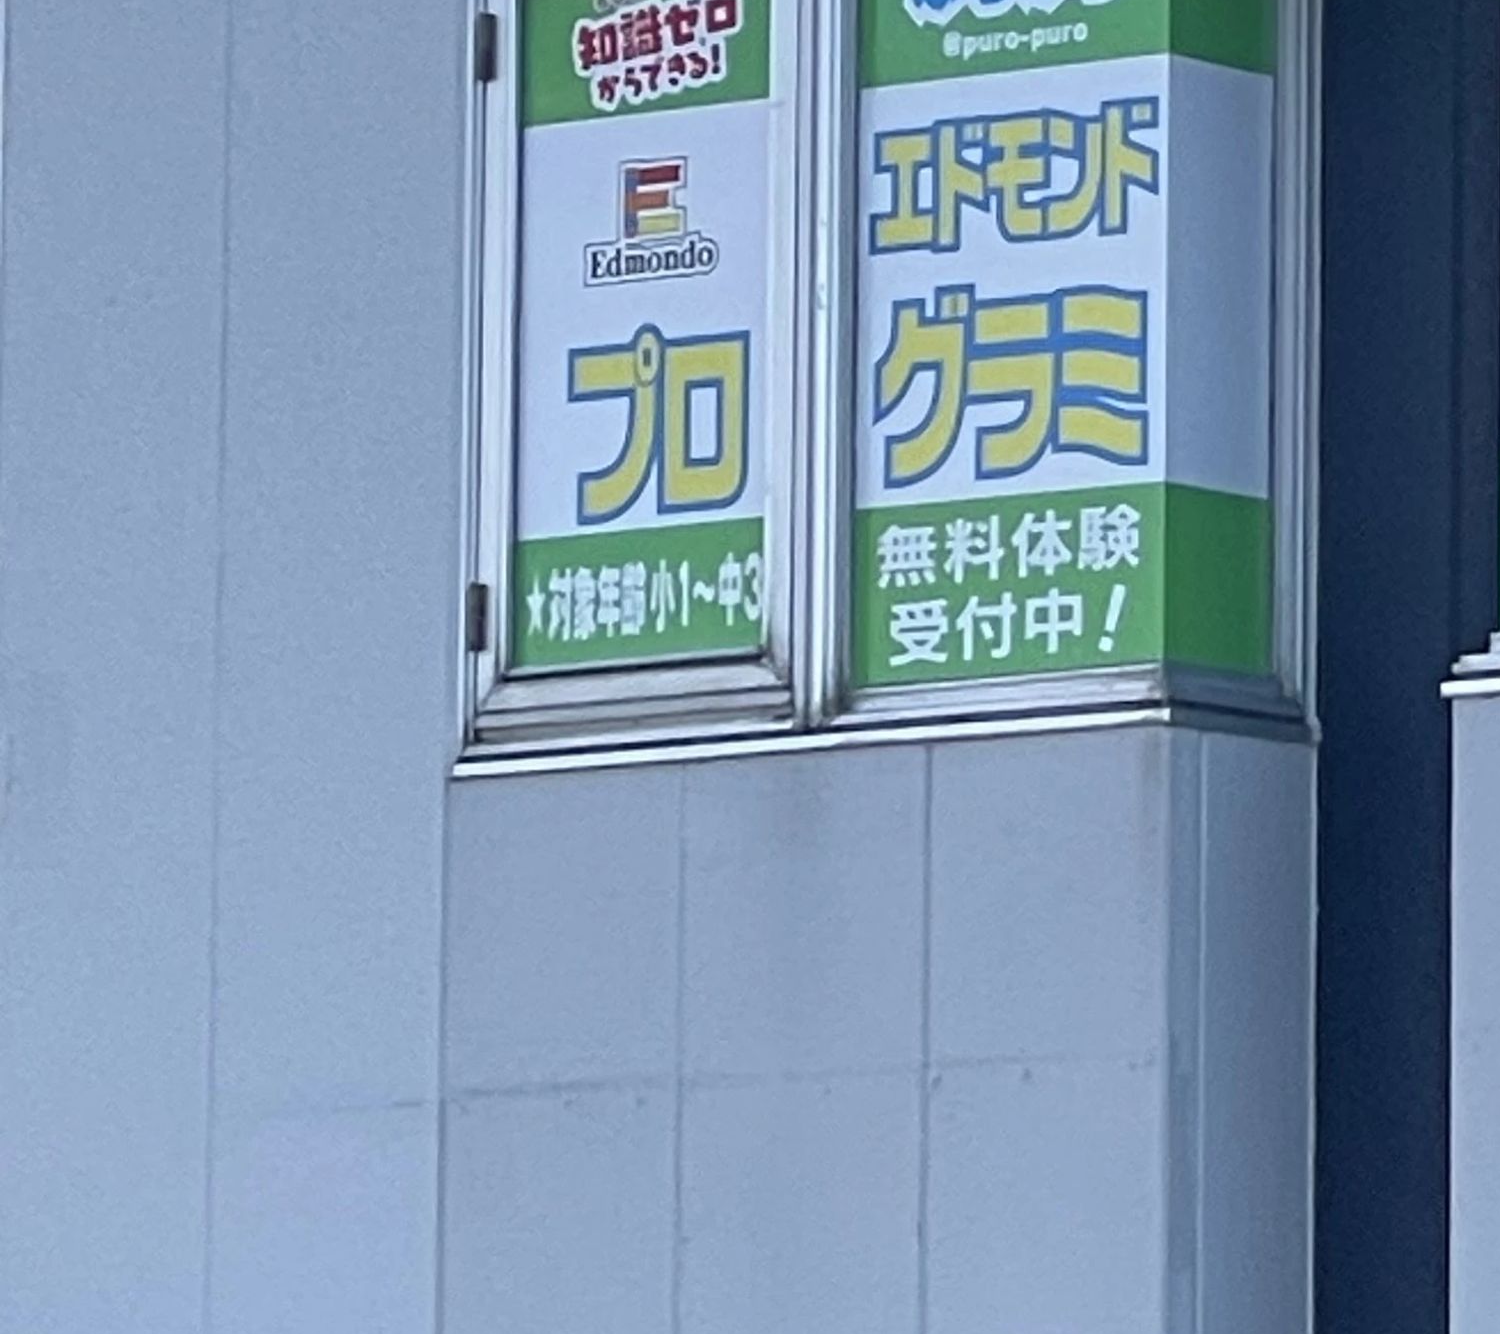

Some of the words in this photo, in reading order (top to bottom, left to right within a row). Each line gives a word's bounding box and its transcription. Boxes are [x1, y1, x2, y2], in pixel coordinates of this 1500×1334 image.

[942, 21, 1089, 61] @puro-puro
[868, 95, 1159, 256] エドモンド
[590, 240, 715, 280] Edmondo
[876, 503, 1142, 589] 無料体験
[888, 584, 1127, 667] 受付中!
